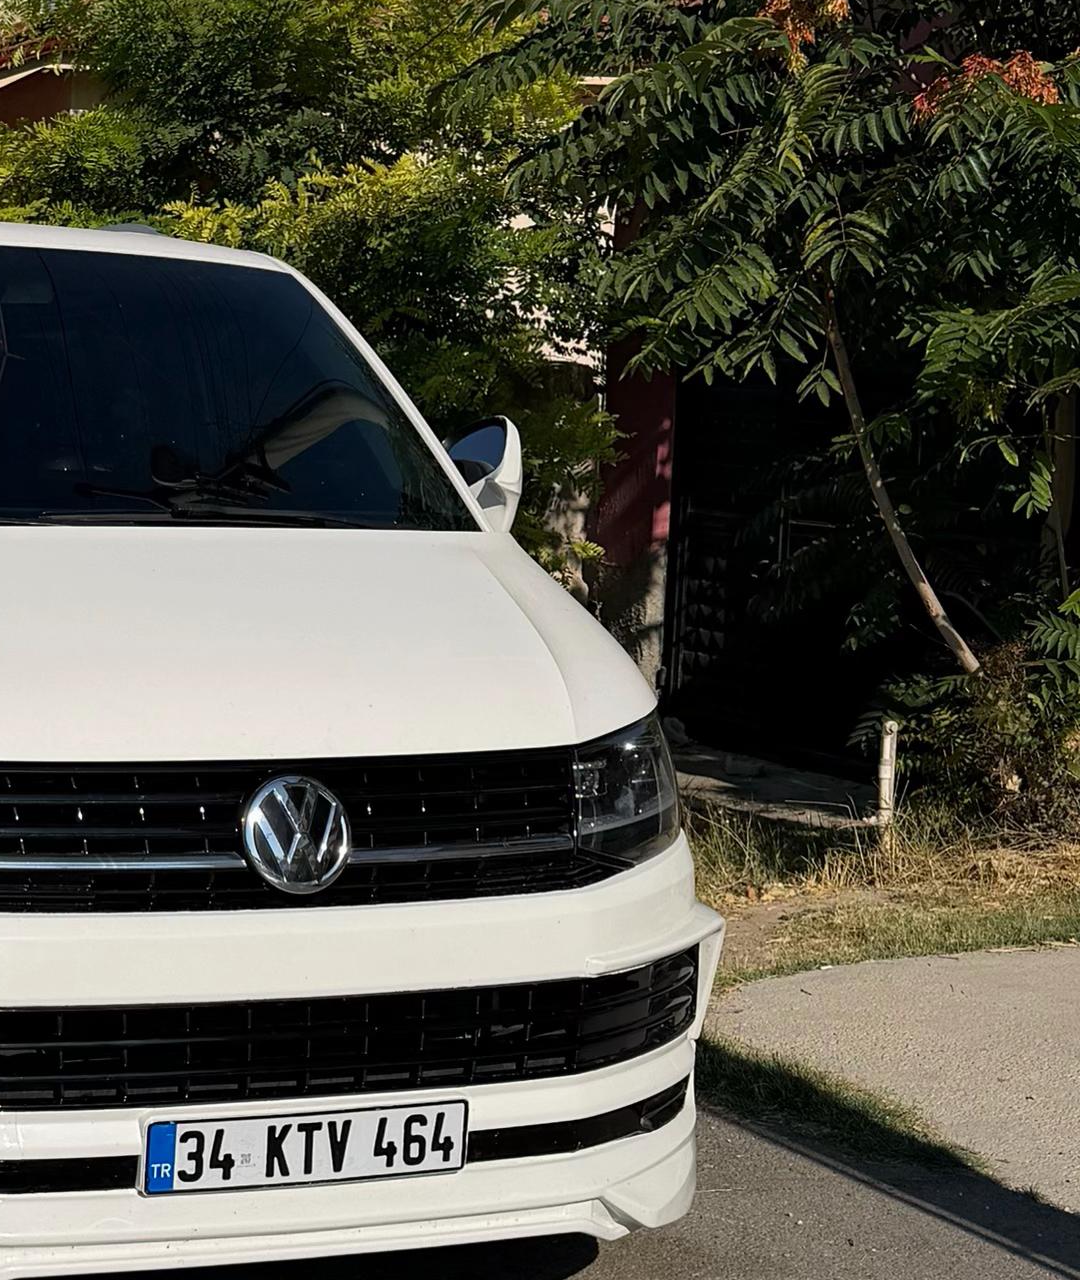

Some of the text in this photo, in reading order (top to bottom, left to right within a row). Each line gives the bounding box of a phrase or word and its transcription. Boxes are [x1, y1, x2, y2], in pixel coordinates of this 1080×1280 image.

[177, 1112, 455, 1183] 34 KTV 464
[151, 1163, 172, 1179] TR
